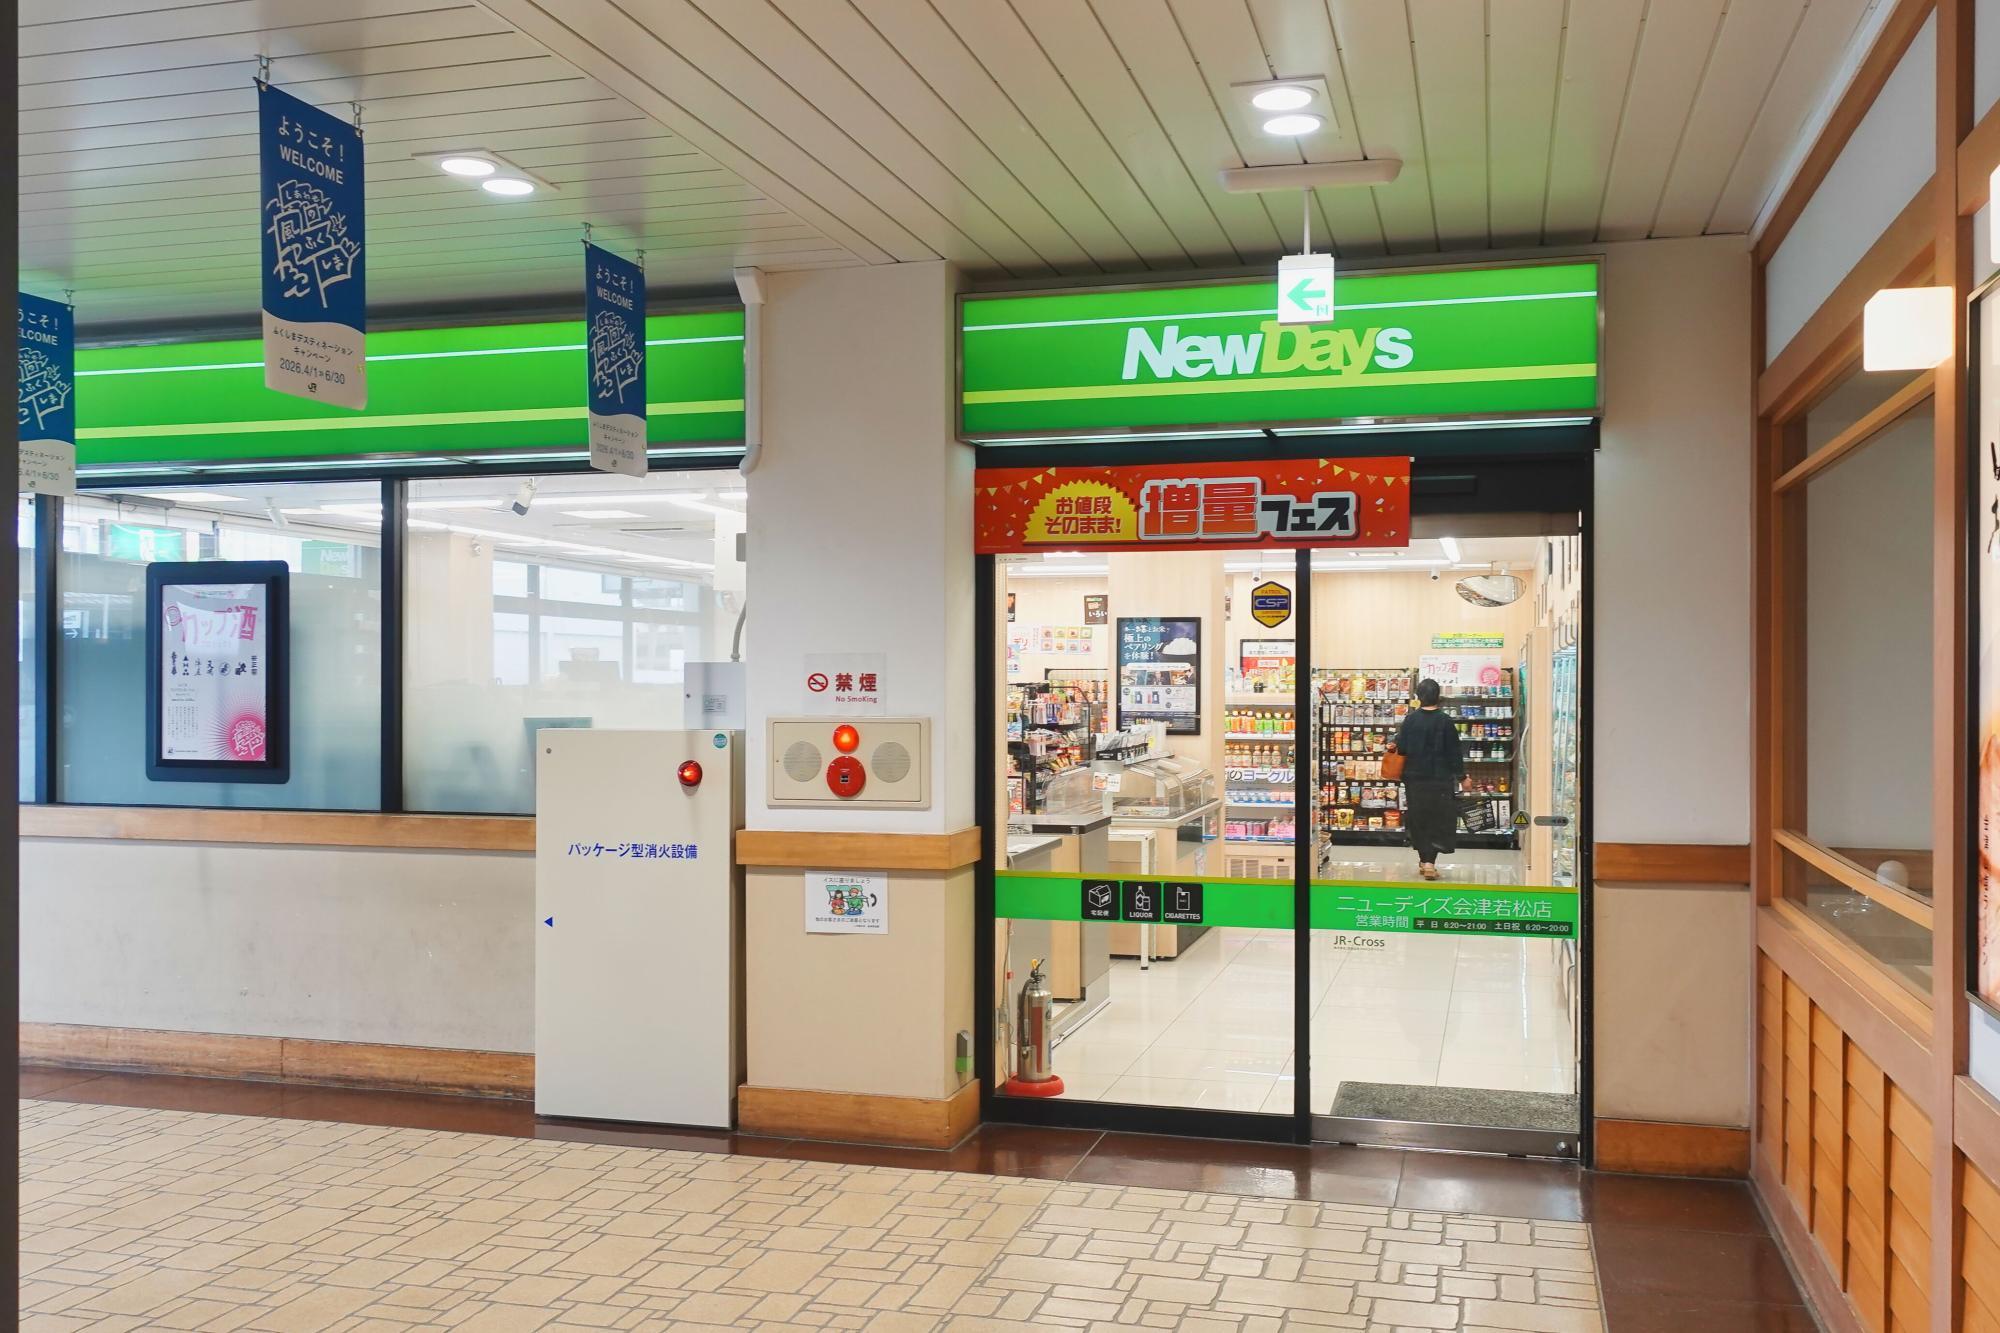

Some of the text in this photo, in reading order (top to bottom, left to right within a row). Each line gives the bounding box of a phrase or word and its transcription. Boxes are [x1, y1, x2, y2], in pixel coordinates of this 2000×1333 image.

[278, 115, 344, 162] ようこそ！
[279, 144, 344, 185] WELCOME
[596, 286, 633, 311] WELCOME
[293, 345, 332, 363] キャンペーン
[1055, 495, 1112, 515] お値段
[1044, 515, 1121, 534] そのまま！
[1255, 598, 1288, 608] CSP
[835, 672, 877, 692] 禁煙
[835, 695, 846, 703] No
[568, 842, 698, 860] パッケージ型消火設備
[1164, 912, 1201, 920] CIGARETTES
[1336, 896, 1553, 918] ニューデイズ会津若松店
[1355, 914, 1409, 929] 営業時間
[1494, 922, 1521, 931] 土日祝
